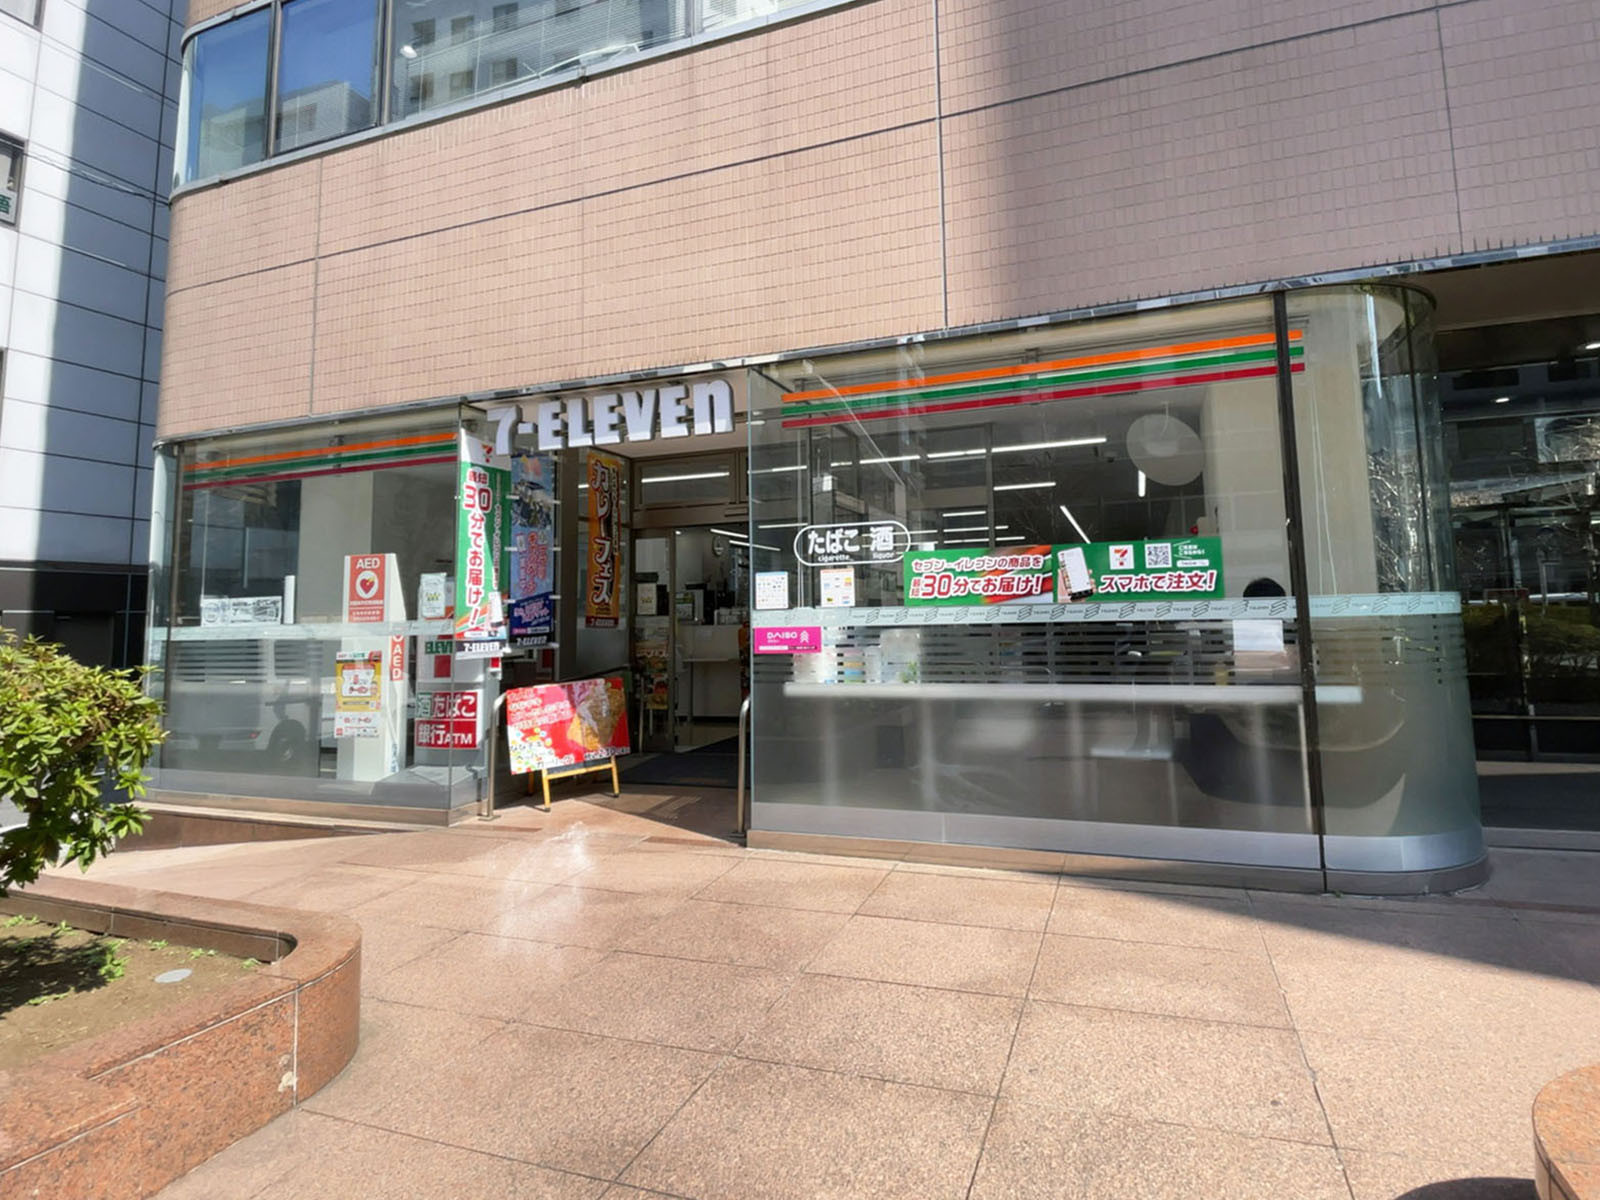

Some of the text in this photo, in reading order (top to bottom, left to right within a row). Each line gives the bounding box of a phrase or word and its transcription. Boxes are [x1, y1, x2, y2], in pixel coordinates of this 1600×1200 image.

[808, 527, 894, 554] たばこ 酒
[356, 557, 381, 569] AED
[1099, 570, 1217, 593] スマホで注文!
[767, 631, 798, 640] DAISO
[418, 723, 473, 745] 銀行ATM
